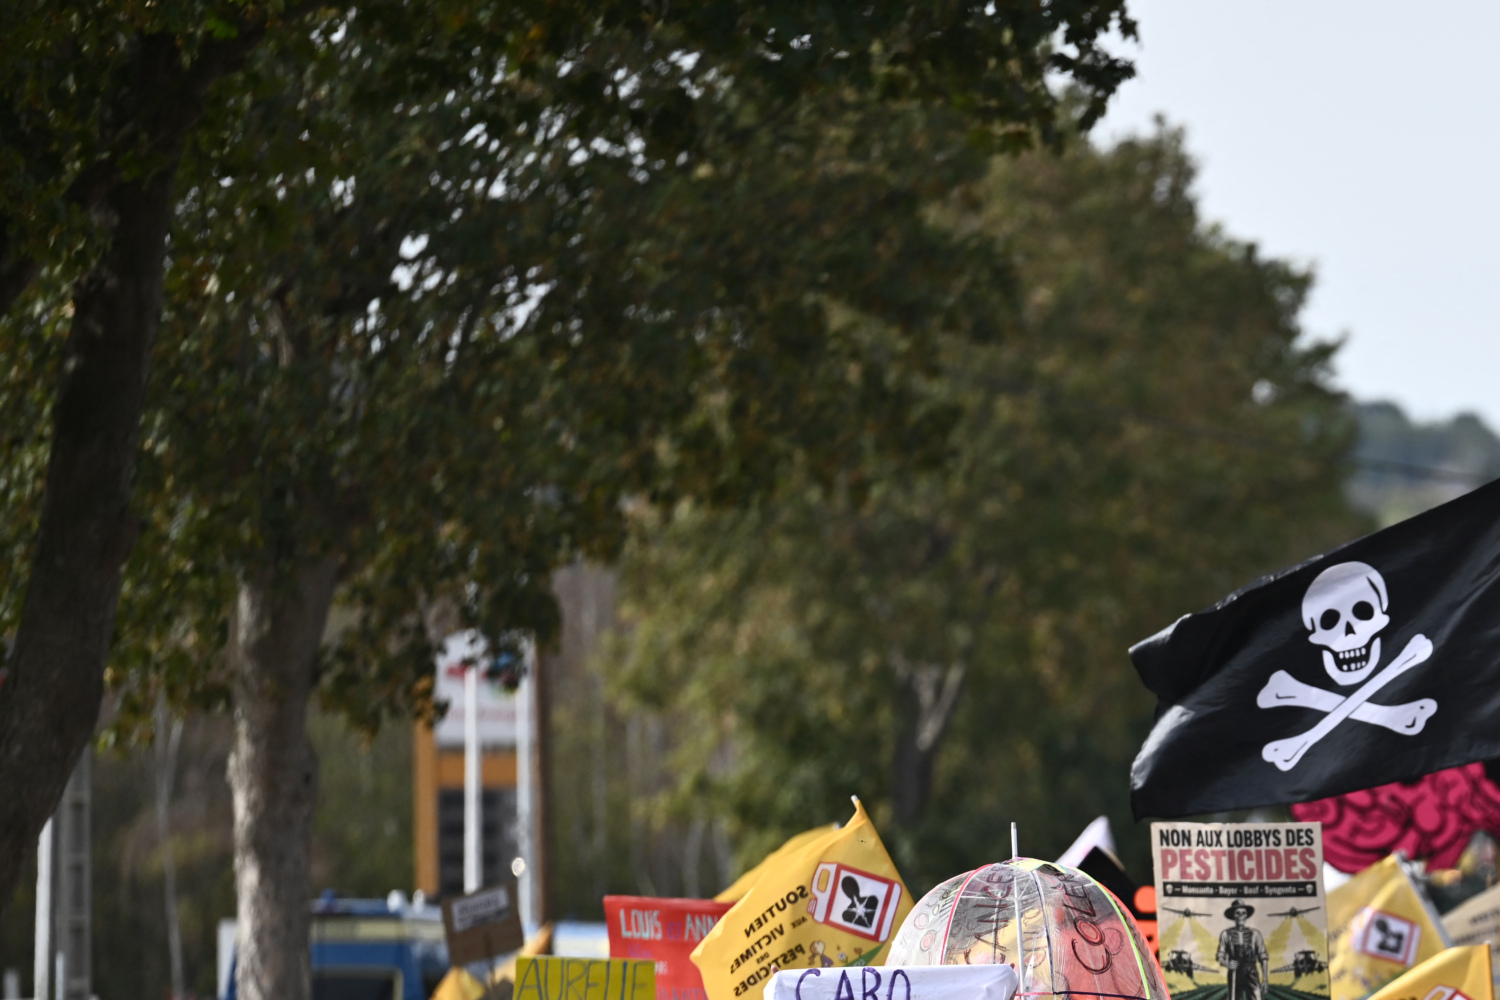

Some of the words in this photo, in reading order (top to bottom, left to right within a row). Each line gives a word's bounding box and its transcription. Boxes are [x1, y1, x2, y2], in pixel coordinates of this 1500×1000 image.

[1159, 829, 1191, 846] NON
[1196, 830, 1222, 847] AUX
[1226, 829, 1281, 848] LOBBYS
[1286, 829, 1314, 846] DES
[1161, 848, 1317, 881] PESTICIDES
[1182, 885, 1214, 894] Monsanto
[1218, 886, 1238, 896] Bayer
[1243, 885, 1258, 894] Basf
[1264, 885, 1296, 896] Syngenta
[620, 908, 663, 940] LOUIS
